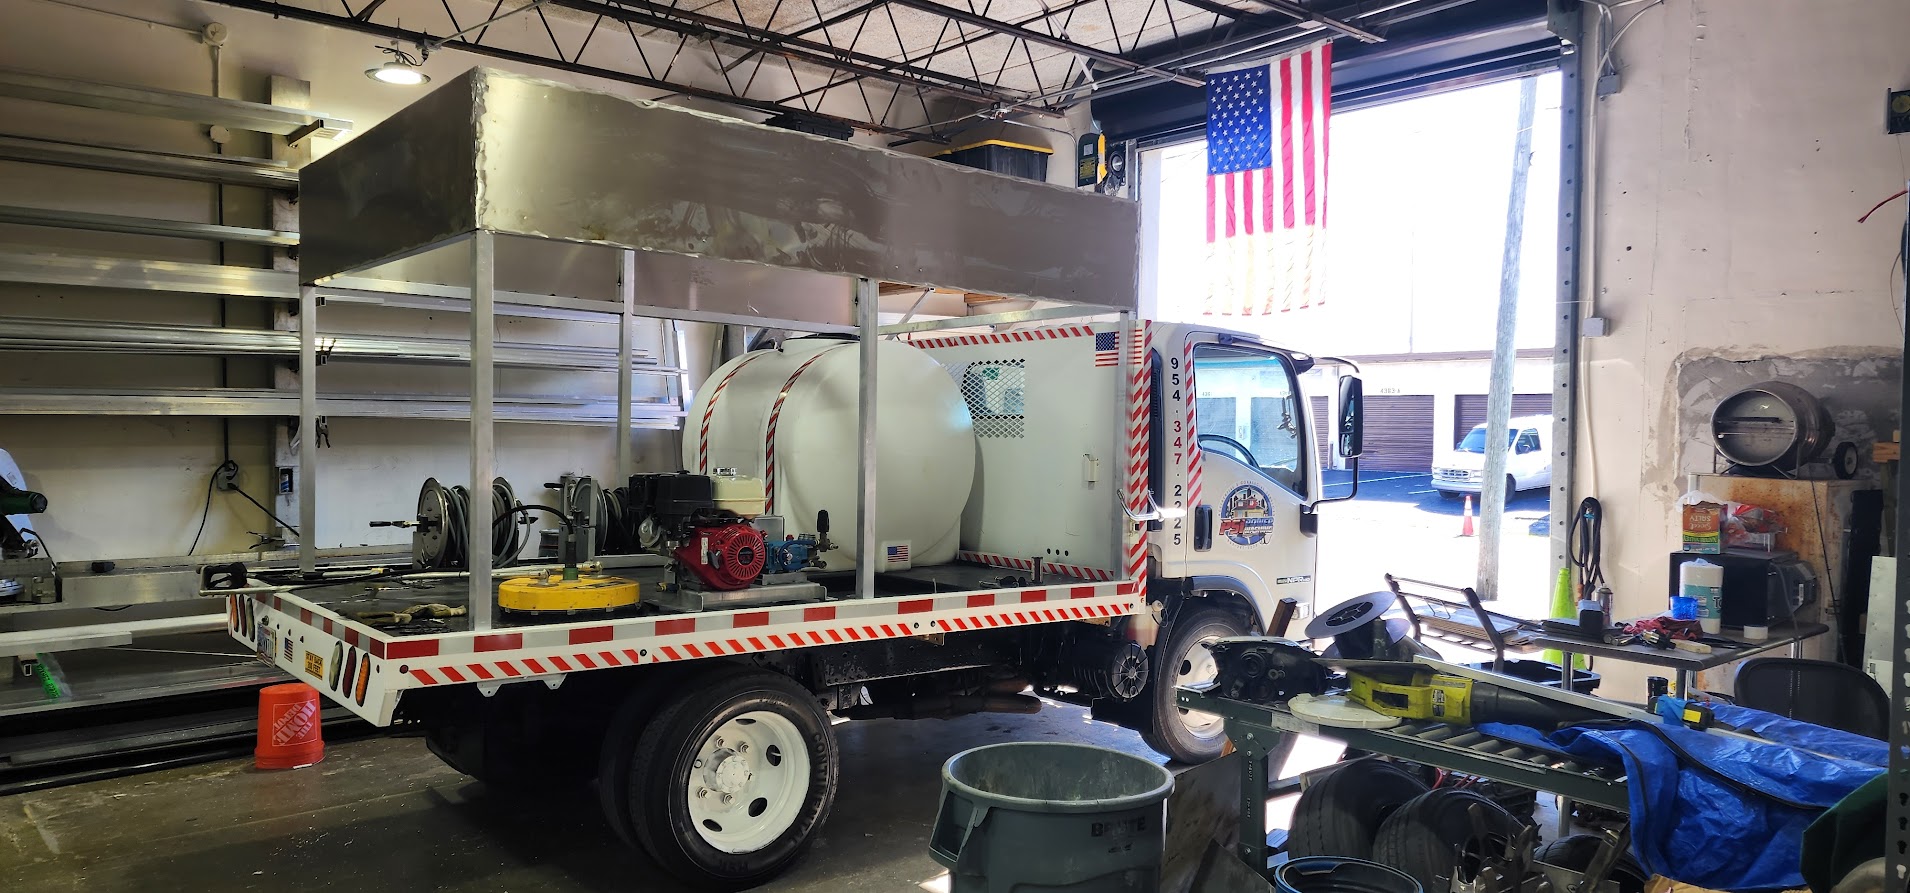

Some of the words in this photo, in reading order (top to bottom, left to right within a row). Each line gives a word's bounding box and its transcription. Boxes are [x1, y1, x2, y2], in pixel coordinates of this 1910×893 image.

[1219, 518, 1246, 535] PSI
[273, 700, 316, 746] HOME
[274, 702, 301, 731] DEPOT
[296, 721, 313, 740] THE
